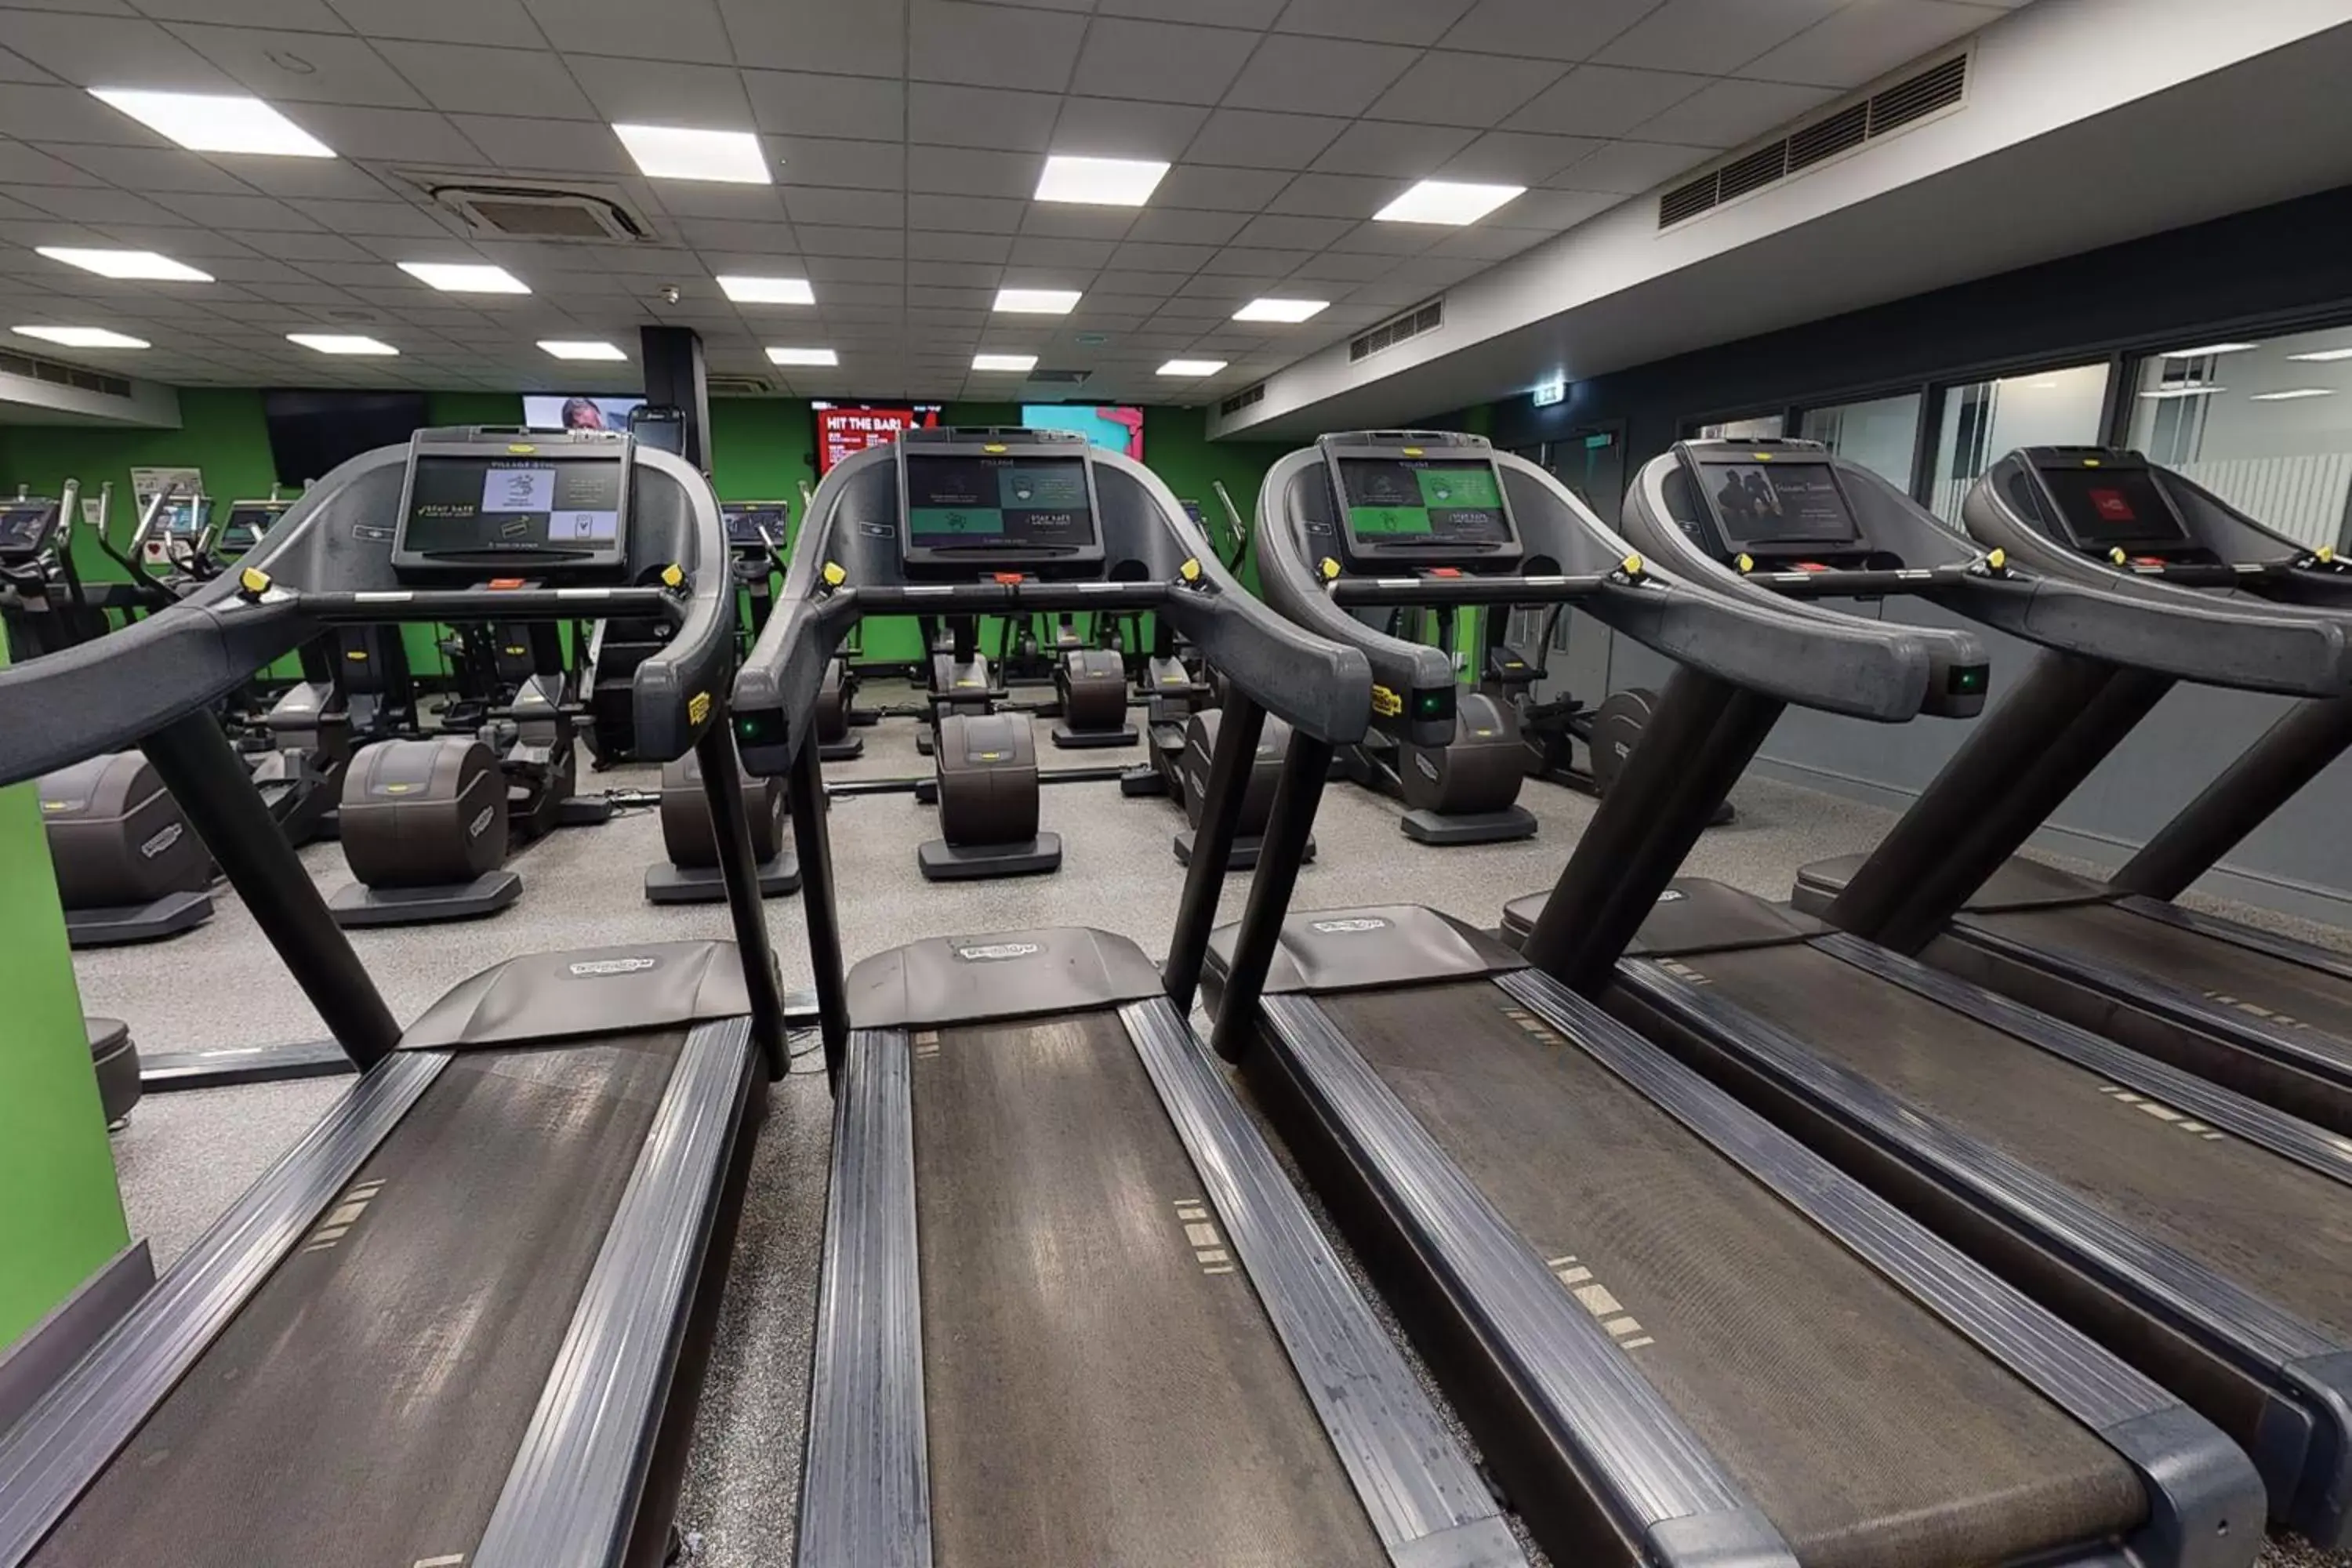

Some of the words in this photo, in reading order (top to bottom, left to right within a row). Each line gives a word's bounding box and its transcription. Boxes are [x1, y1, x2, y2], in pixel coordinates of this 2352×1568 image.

[827, 417, 847, 430] HIT
[849, 417, 871, 430] THE
[873, 417, 902, 430] BAR!
